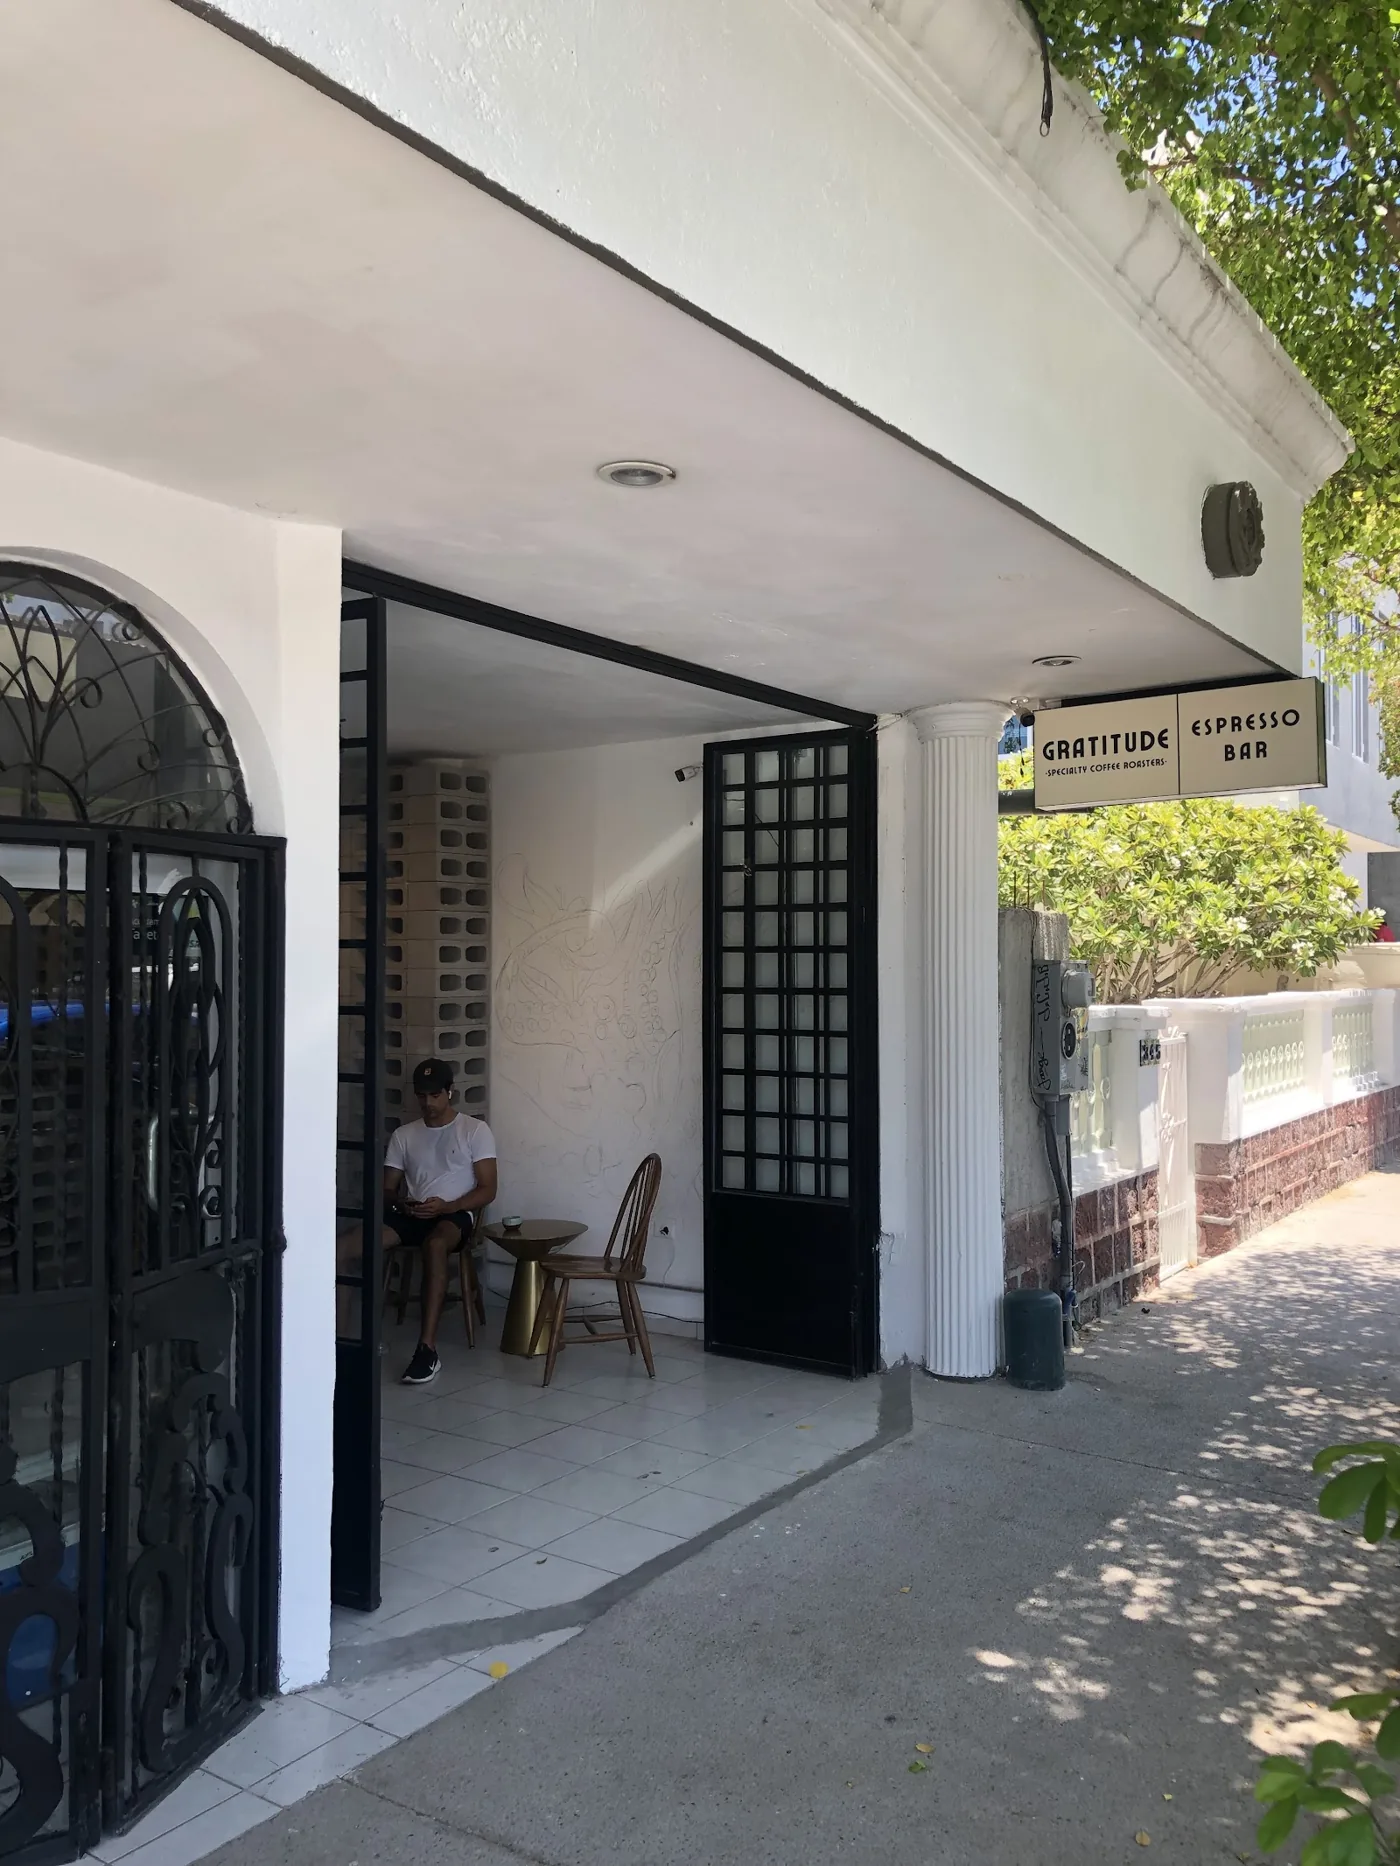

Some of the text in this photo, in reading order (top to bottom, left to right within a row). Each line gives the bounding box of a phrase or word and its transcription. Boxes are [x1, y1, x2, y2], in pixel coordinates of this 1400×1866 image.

[1191, 708, 1300, 737] ESPRESSO
[1042, 728, 1169, 761] GRATITUDE
[1224, 740, 1268, 762] BAR
[1090, 762, 1121, 773] COFFEE
